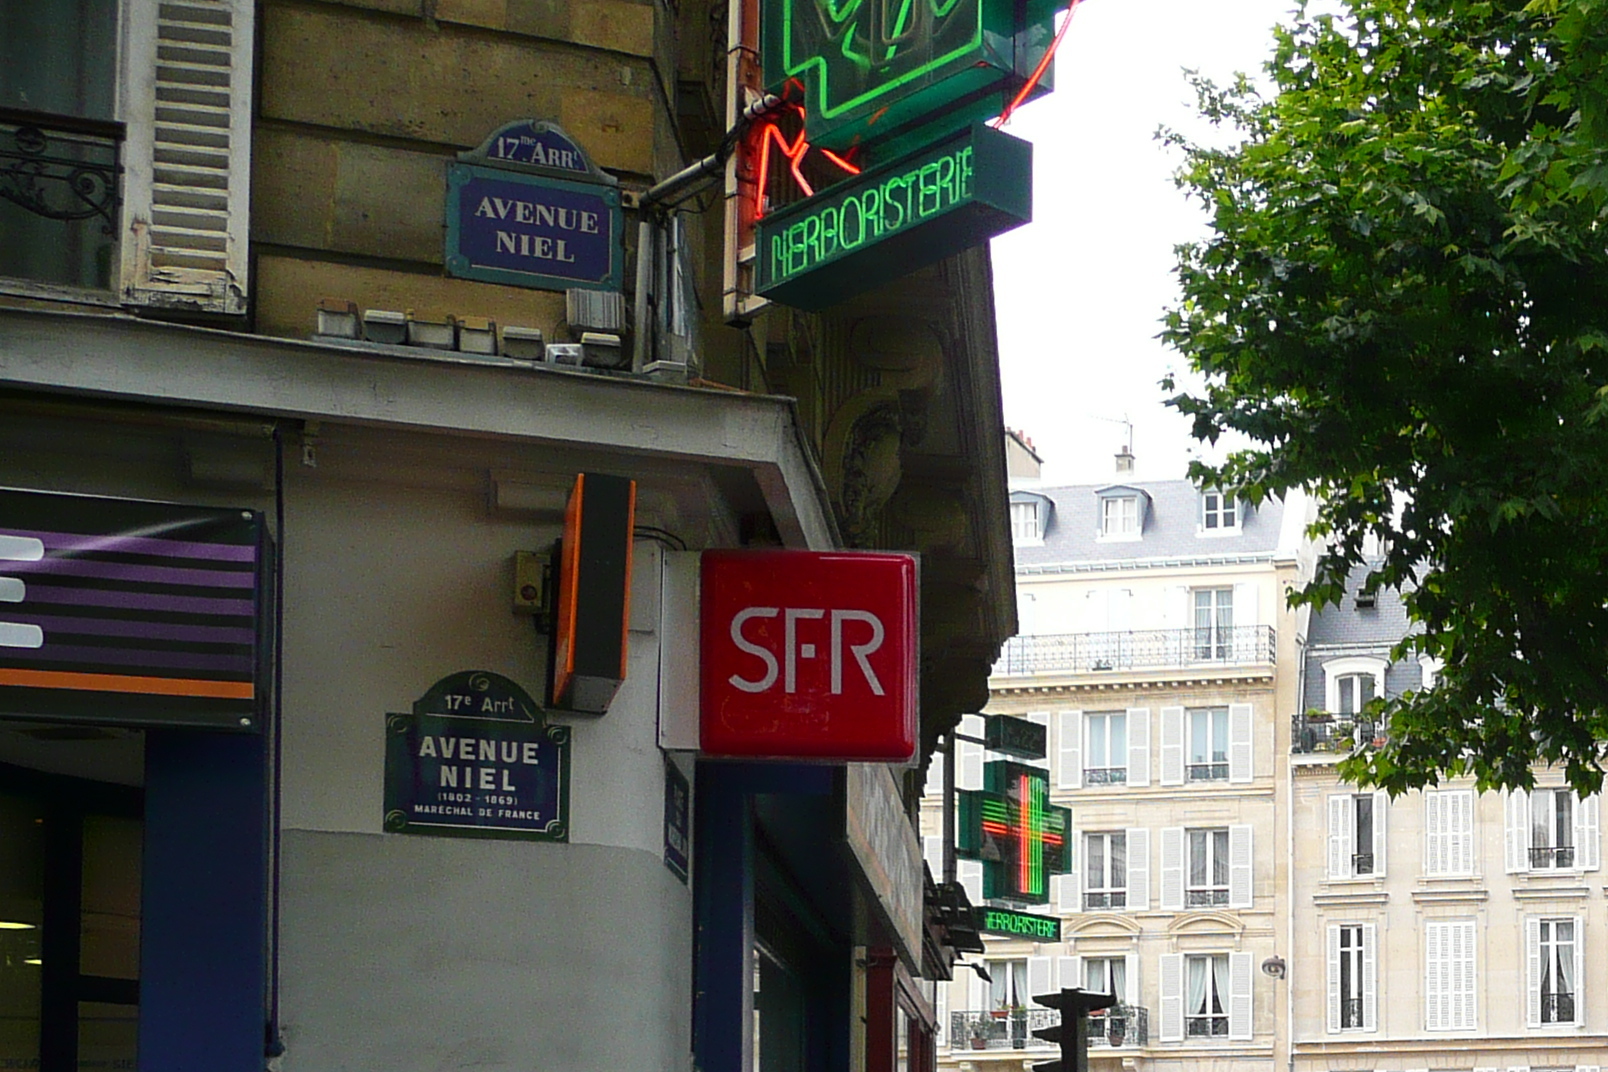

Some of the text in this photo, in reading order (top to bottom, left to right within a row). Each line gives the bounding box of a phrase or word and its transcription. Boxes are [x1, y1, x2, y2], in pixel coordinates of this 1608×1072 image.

[474, 196, 599, 234] AVENUE
[496, 230, 575, 263] NIEL
[728, 606, 886, 696] SFR
[418, 736, 539, 765] AVENUE
[440, 765, 516, 791] NIEL
[414, 804, 540, 820] MARÉCHAL DE FRANCE
